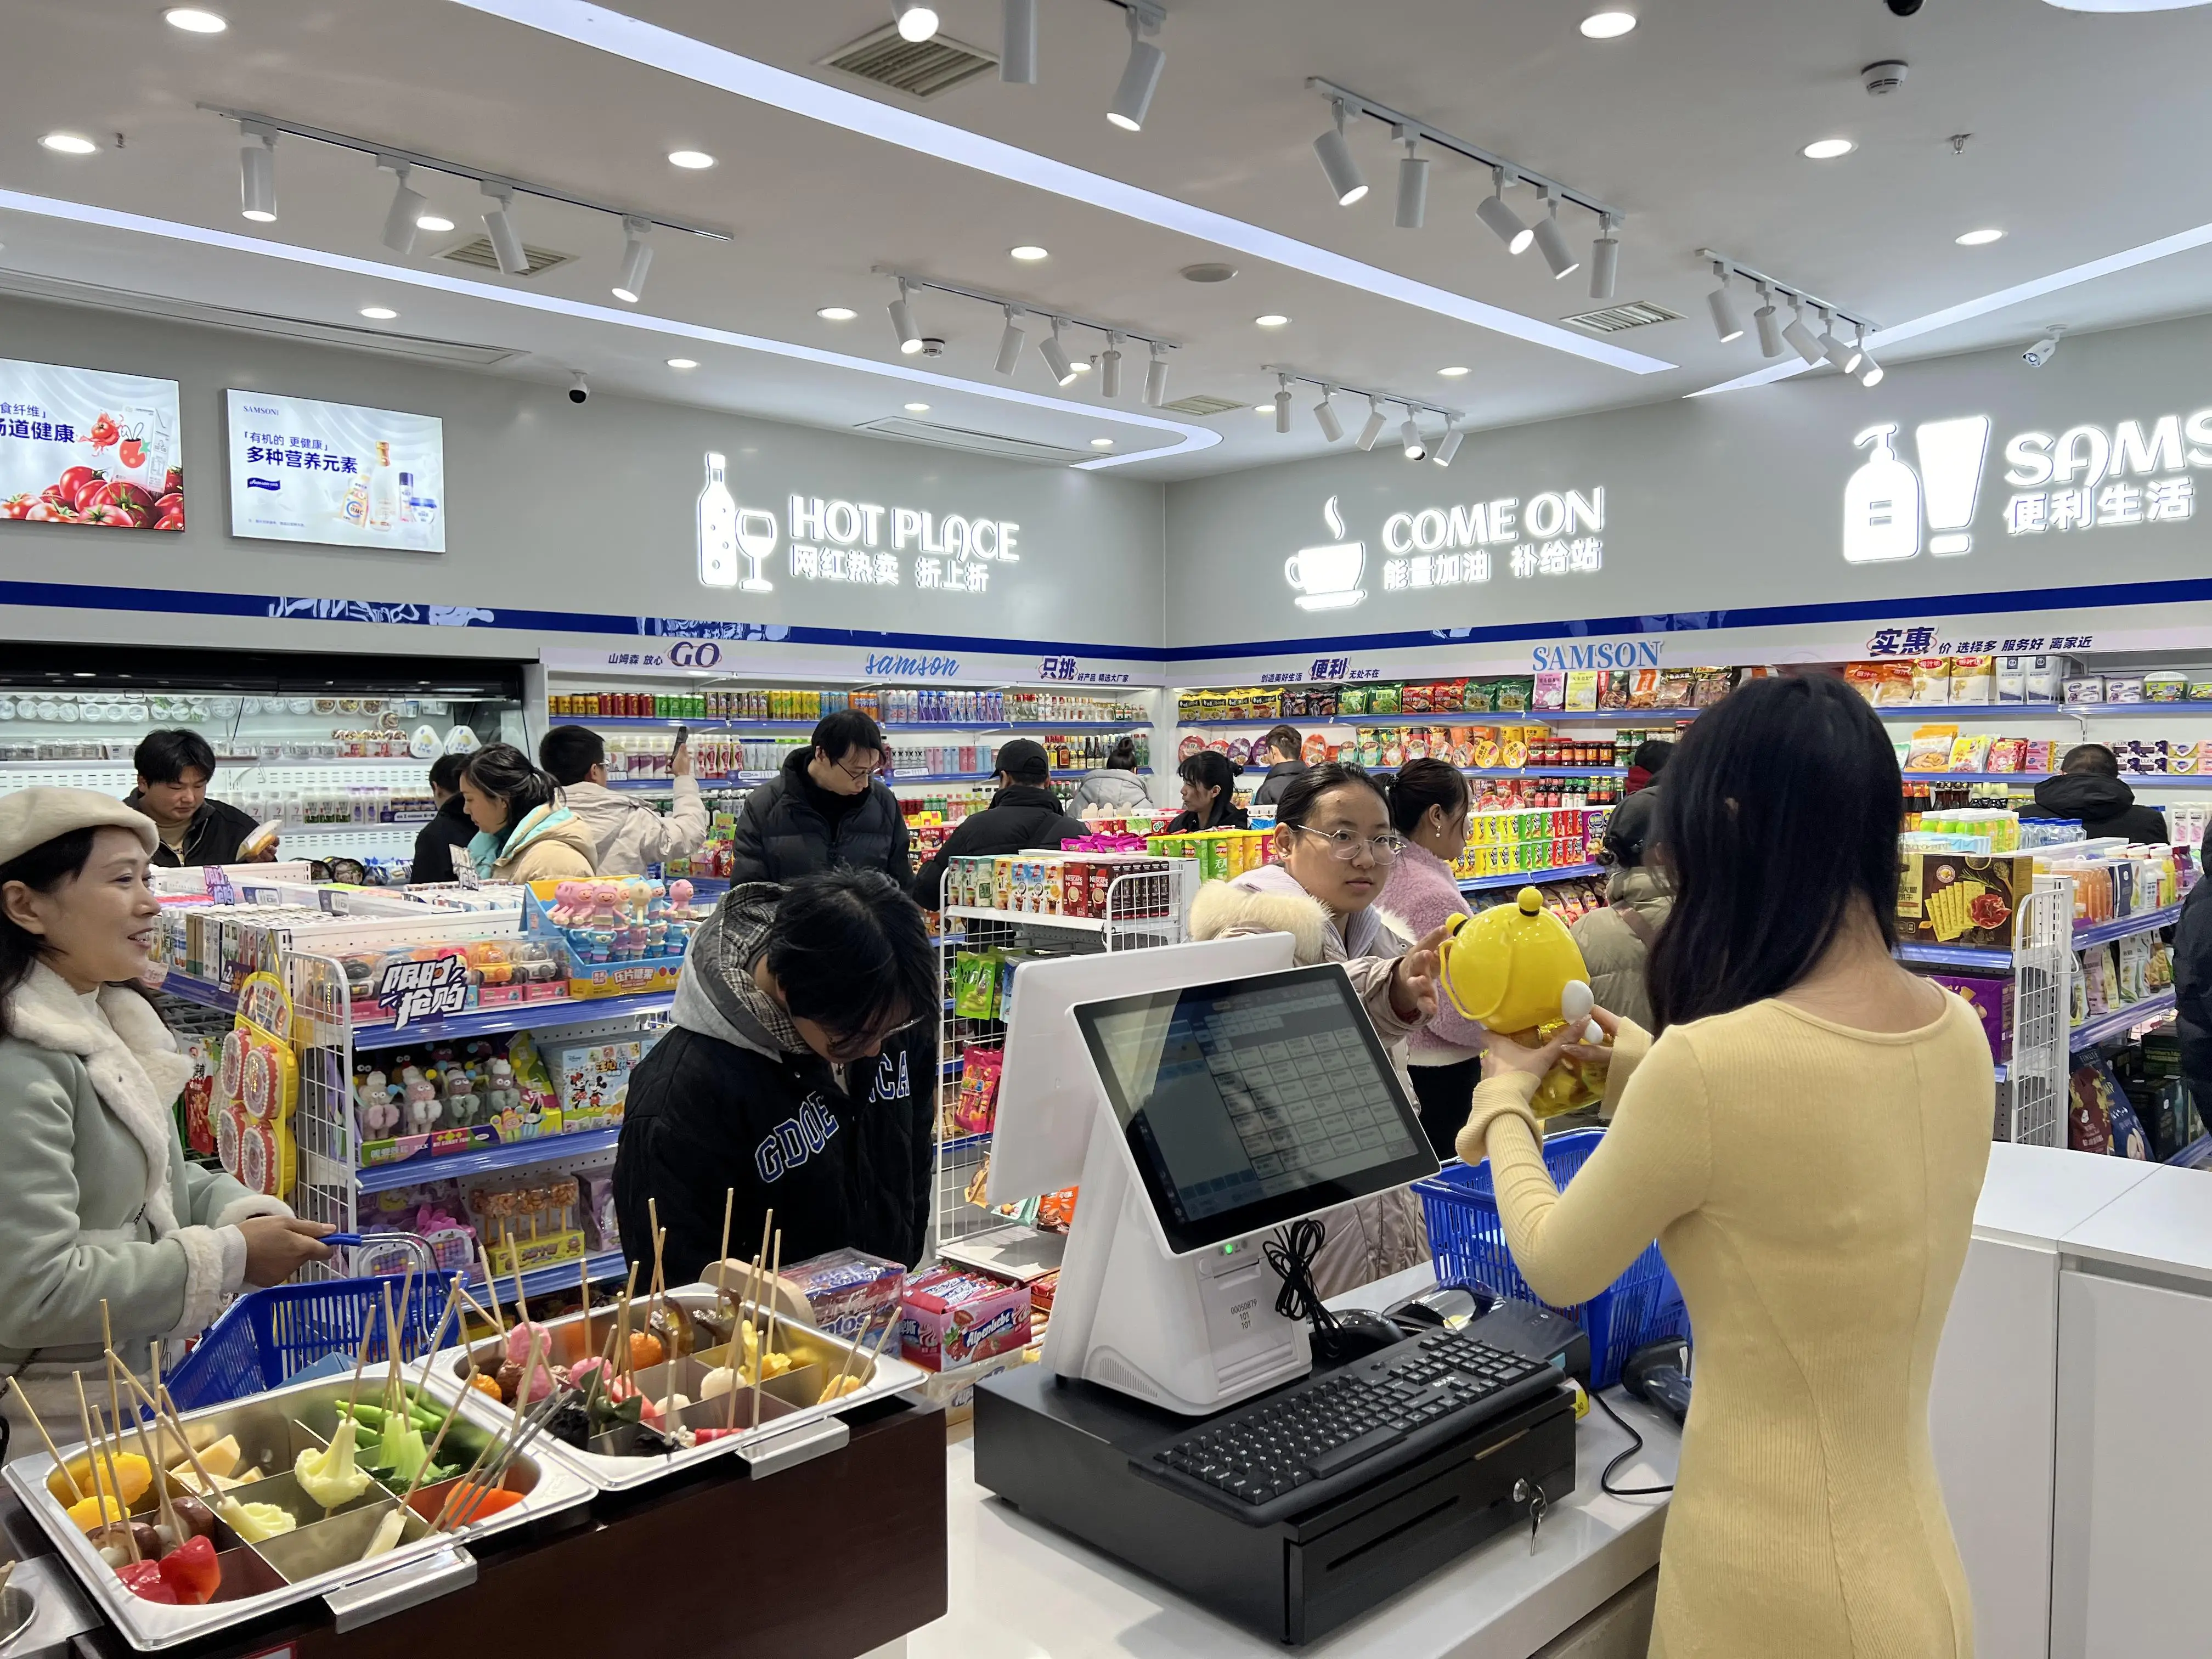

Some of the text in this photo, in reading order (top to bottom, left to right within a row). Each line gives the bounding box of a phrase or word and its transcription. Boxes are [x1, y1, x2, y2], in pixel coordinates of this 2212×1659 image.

[0, 417, 75, 443] 道健康
[247, 446, 358, 474] 多种营养元素
[1383, 487, 1604, 554] COME ON
[2004, 477, 2194, 534] 便利生活
[791, 495, 1020, 563] HOT PLACE
[791, 544, 989, 592] 网红热卖 折上折
[1384, 538, 1602, 590] 能量加油 补给站
[670, 641, 720, 667] GO
[1532, 641, 1661, 671] SAMSON
[1870, 627, 2092, 657] 实惠 价 选择多 服务好 离家近
[865, 653, 960, 676] samson
[1041, 658, 1076, 680] 只挑
[1261, 658, 1380, 682] 创造美好生活 便利 无处不在
[381, 957, 455, 994] 限时
[396, 983, 466, 1030] 抢购
[869, 1051, 910, 1103] CA
[1239, 1312, 1249, 1321] 101
[1241, 1321, 1251, 1329] 101
